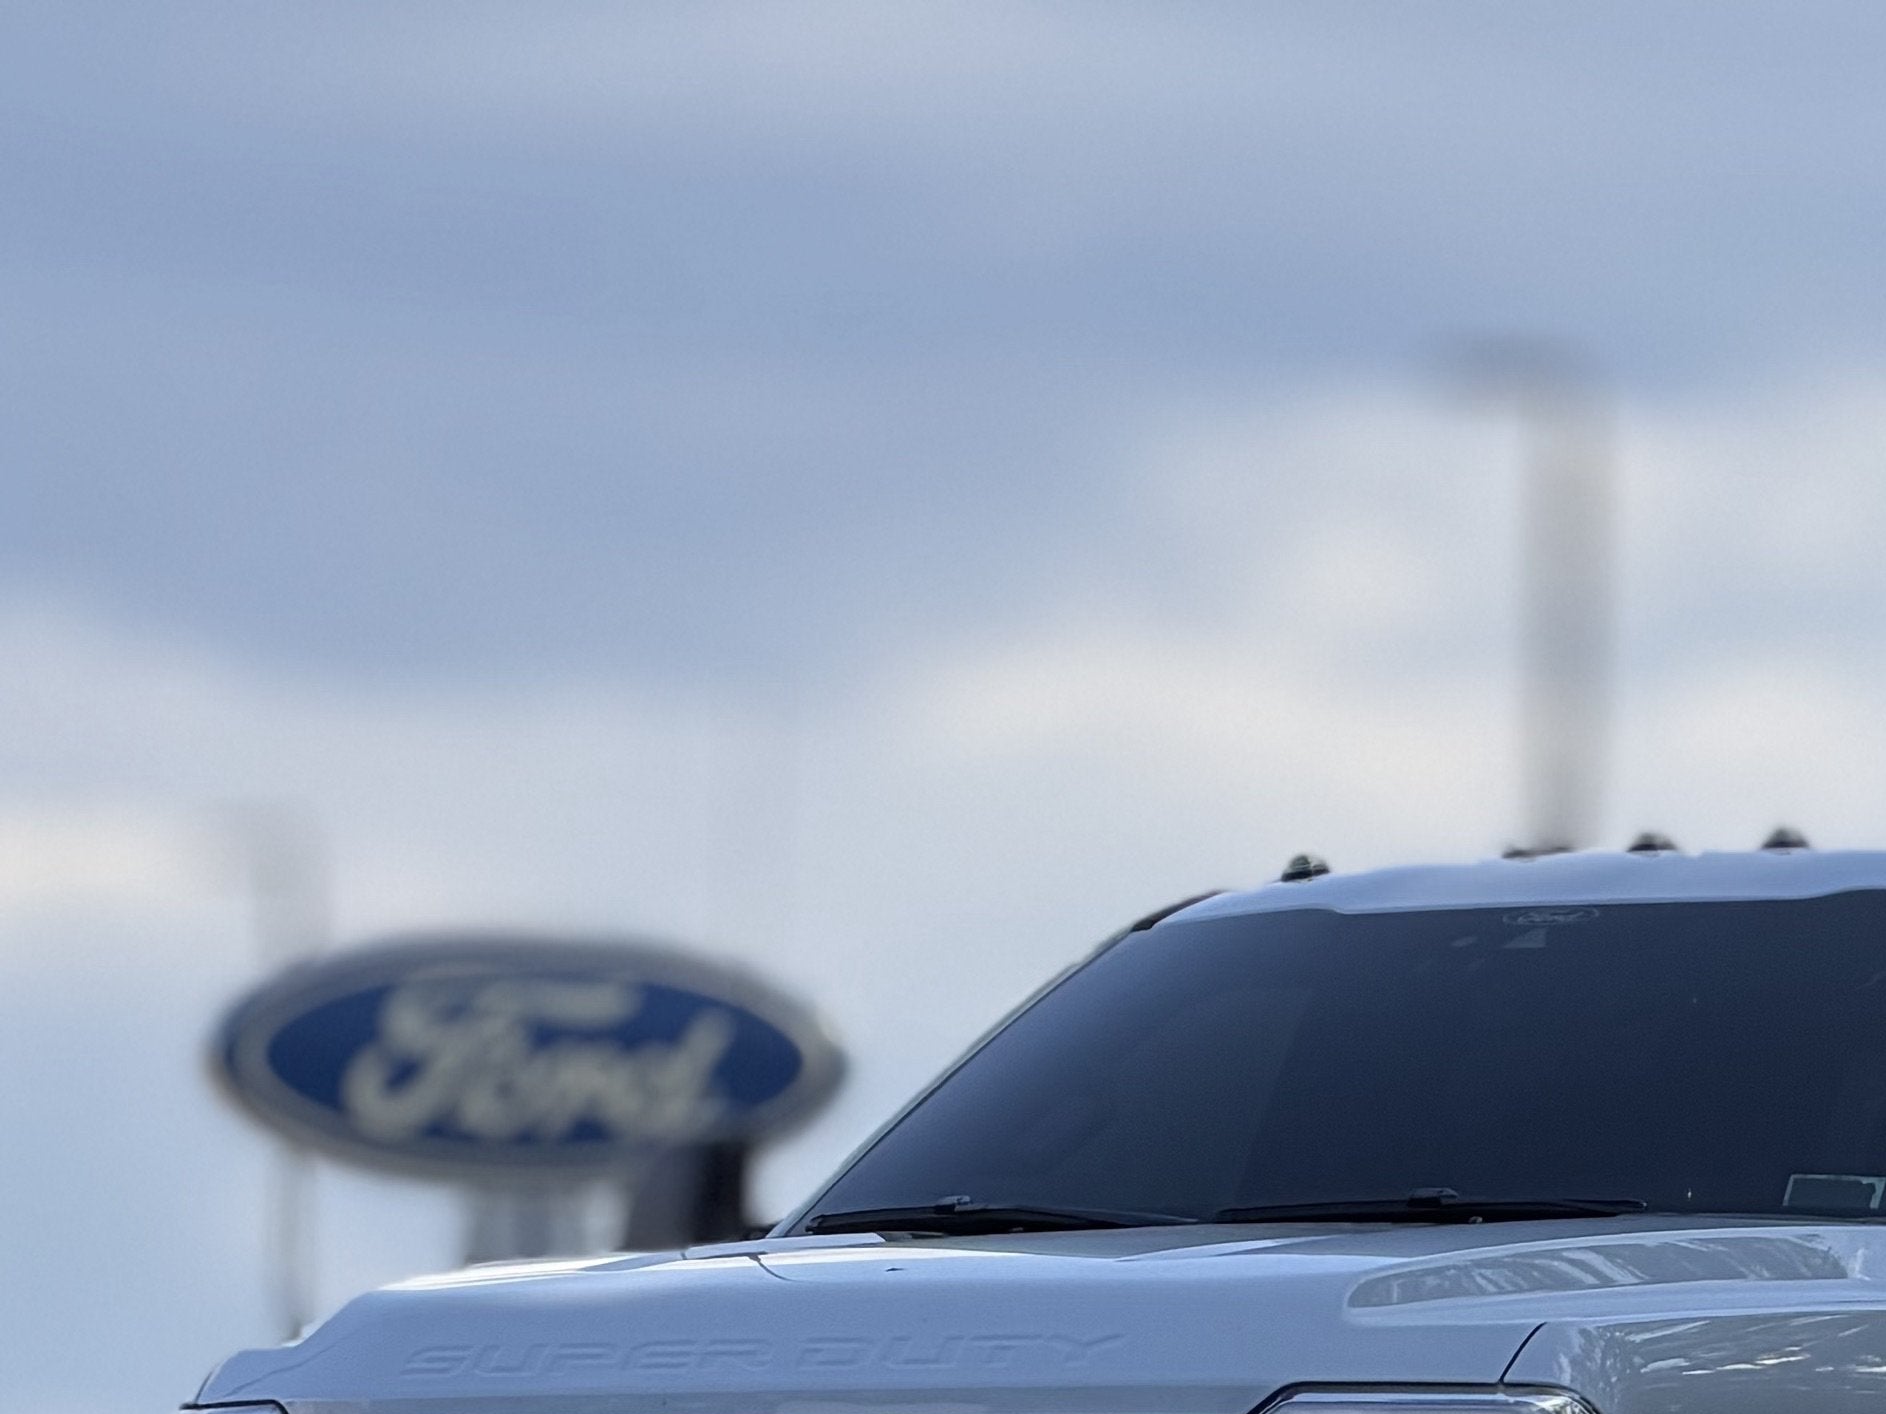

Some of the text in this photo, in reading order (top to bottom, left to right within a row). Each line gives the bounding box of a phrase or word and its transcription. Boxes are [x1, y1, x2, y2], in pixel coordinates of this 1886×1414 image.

[342, 976, 732, 1140] Ford
[402, 1332, 1126, 1380] SUPER DUTY
